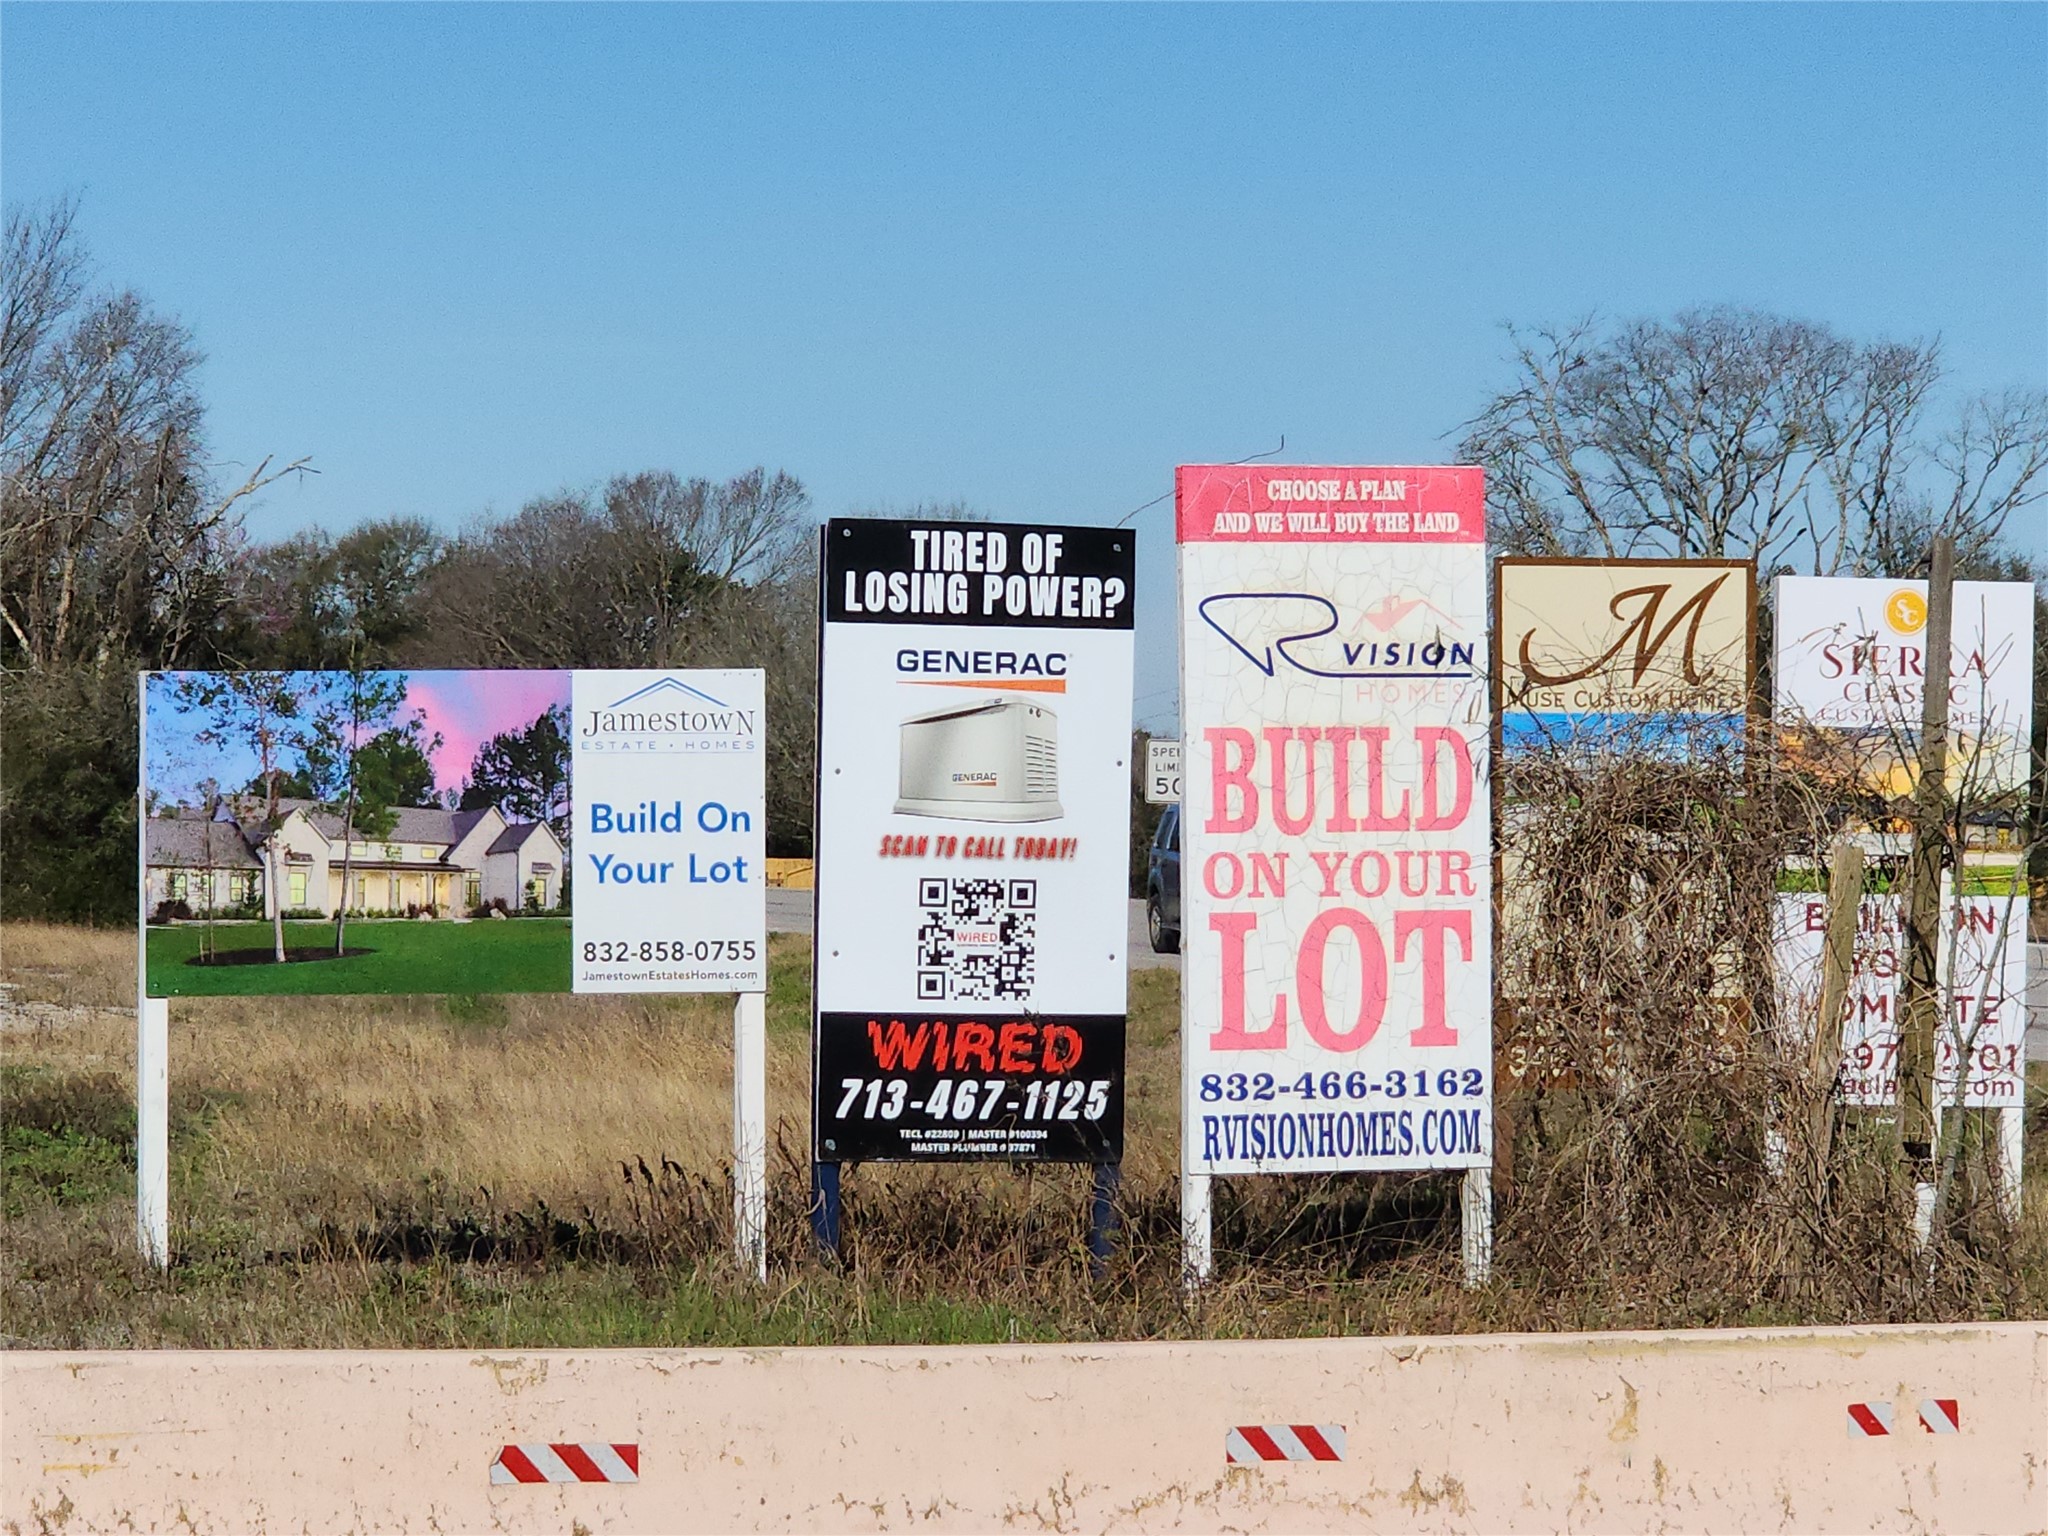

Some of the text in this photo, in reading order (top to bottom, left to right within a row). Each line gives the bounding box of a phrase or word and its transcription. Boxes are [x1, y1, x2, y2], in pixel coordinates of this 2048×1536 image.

[1267, 480, 1406, 501] CHOOSE A PLAN
[1214, 513, 1459, 534] AND WE WILL BUY THE LAND
[911, 530, 1063, 574] TIRED OF
[845, 570, 1126, 618] LOSING POWER?
[896, 649, 1067, 676] GENERAC
[1343, 642, 1475, 666] VISION
[1356, 683, 1465, 703] HOMES
[1844, 682, 1969, 705] CLASC
[581, 740, 755, 750] ESTATE HOMES
[1152, 747, 1180, 757] SPE
[952, 773, 997, 782] GENERAC
[1155, 763, 1179, 772] LIMI
[1203, 726, 1473, 836] BUILD
[591, 801, 751, 833] Build On
[879, 835, 1078, 860] SCAN TO CALL TODAY!
[588, 853, 748, 884] Your Lot
[1203, 850, 1477, 898] ON YOUR
[957, 932, 998, 942] WIRED
[583, 941, 756, 962] 832-858-0755
[582, 970, 758, 981] JamestownEstatesHomes.com
[1208, 906, 1473, 1053] LOT
[868, 1020, 1083, 1073] WIRED
[1200, 1068, 1484, 1101] 832-466-3162
[835, 1078, 1110, 1121] 713-467-1125
[968, 1130, 1007, 1139] MASTER
[1203, 1109, 1482, 1161] RVISIONHOMES.COM
[911, 1143, 950, 1152] MASTER
[952, 1143, 998, 1152] PLUMBER
